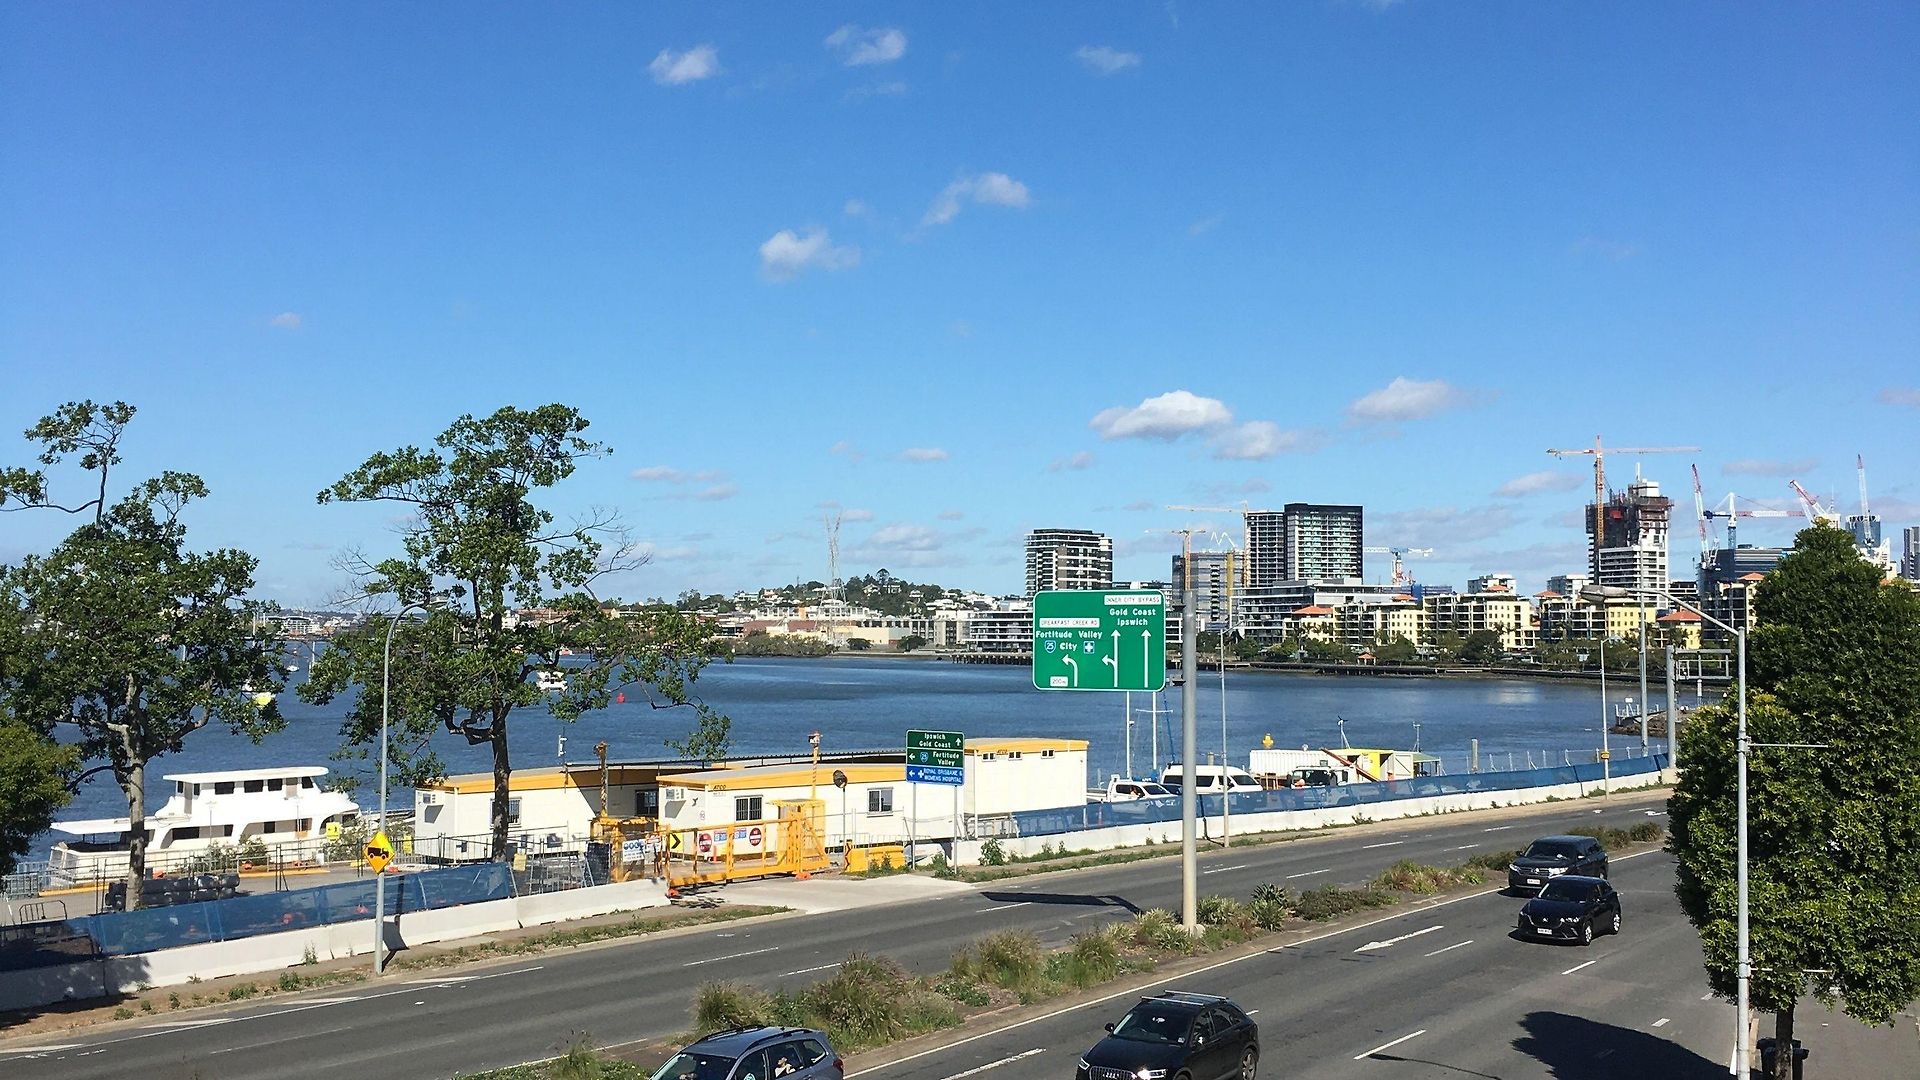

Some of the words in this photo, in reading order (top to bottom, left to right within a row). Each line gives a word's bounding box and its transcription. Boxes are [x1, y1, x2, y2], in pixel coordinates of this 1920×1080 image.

[1109, 608, 1128, 616] Gold
[1132, 608, 1156, 616] Coast
[1117, 618, 1148, 627] Ipswich
[1035, 630, 1073, 639] Fortitude
[1078, 630, 1103, 640] Valley
[1046, 642, 1054, 650] 25
[1059, 642, 1078, 651] City
[924, 732, 946, 740] Ipswich
[932, 751, 960, 759] Fortitude
[937, 758, 956, 767] Valley
